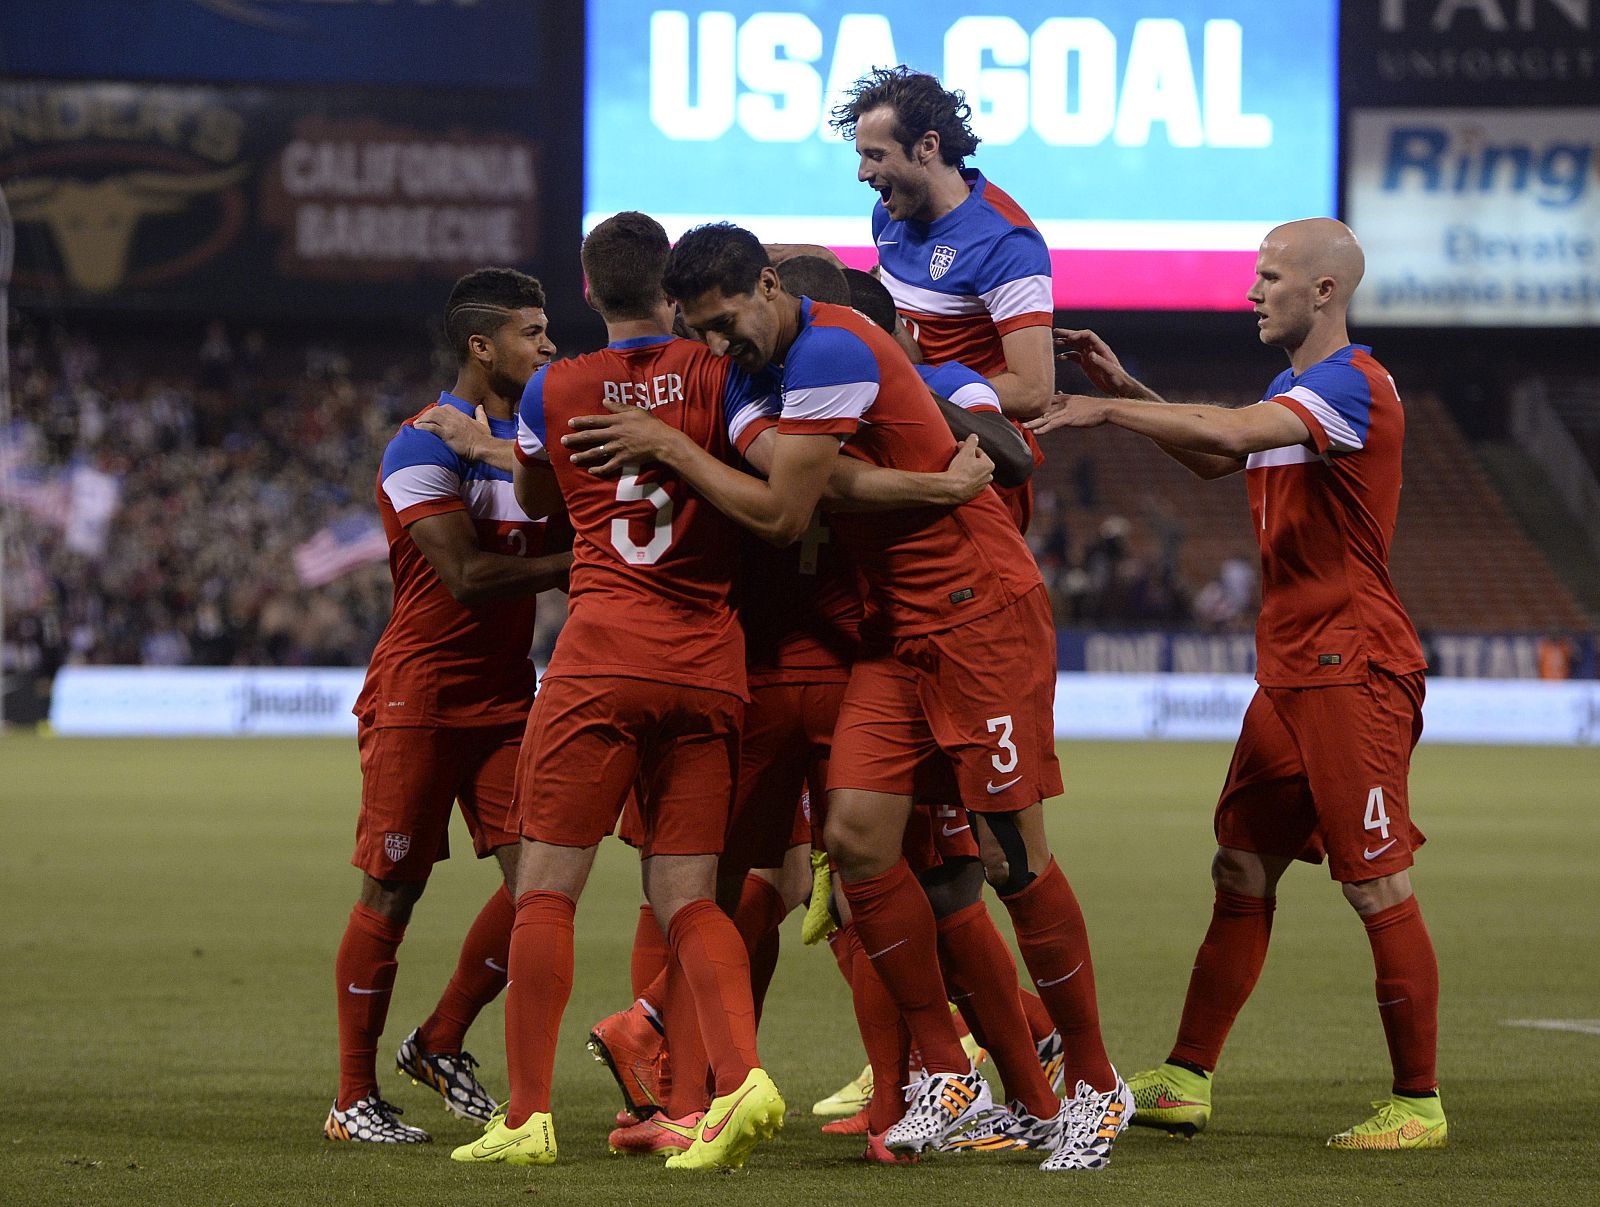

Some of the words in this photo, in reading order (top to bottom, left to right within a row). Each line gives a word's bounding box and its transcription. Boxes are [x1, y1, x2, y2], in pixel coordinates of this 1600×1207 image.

[649, 9, 900, 143] USA
[943, 14, 1274, 148] GOAL
[603, 373, 684, 411] BESLER
[611, 462, 673, 564] 5
[986, 714, 1019, 774] 3
[1363, 786, 1390, 840] 4
